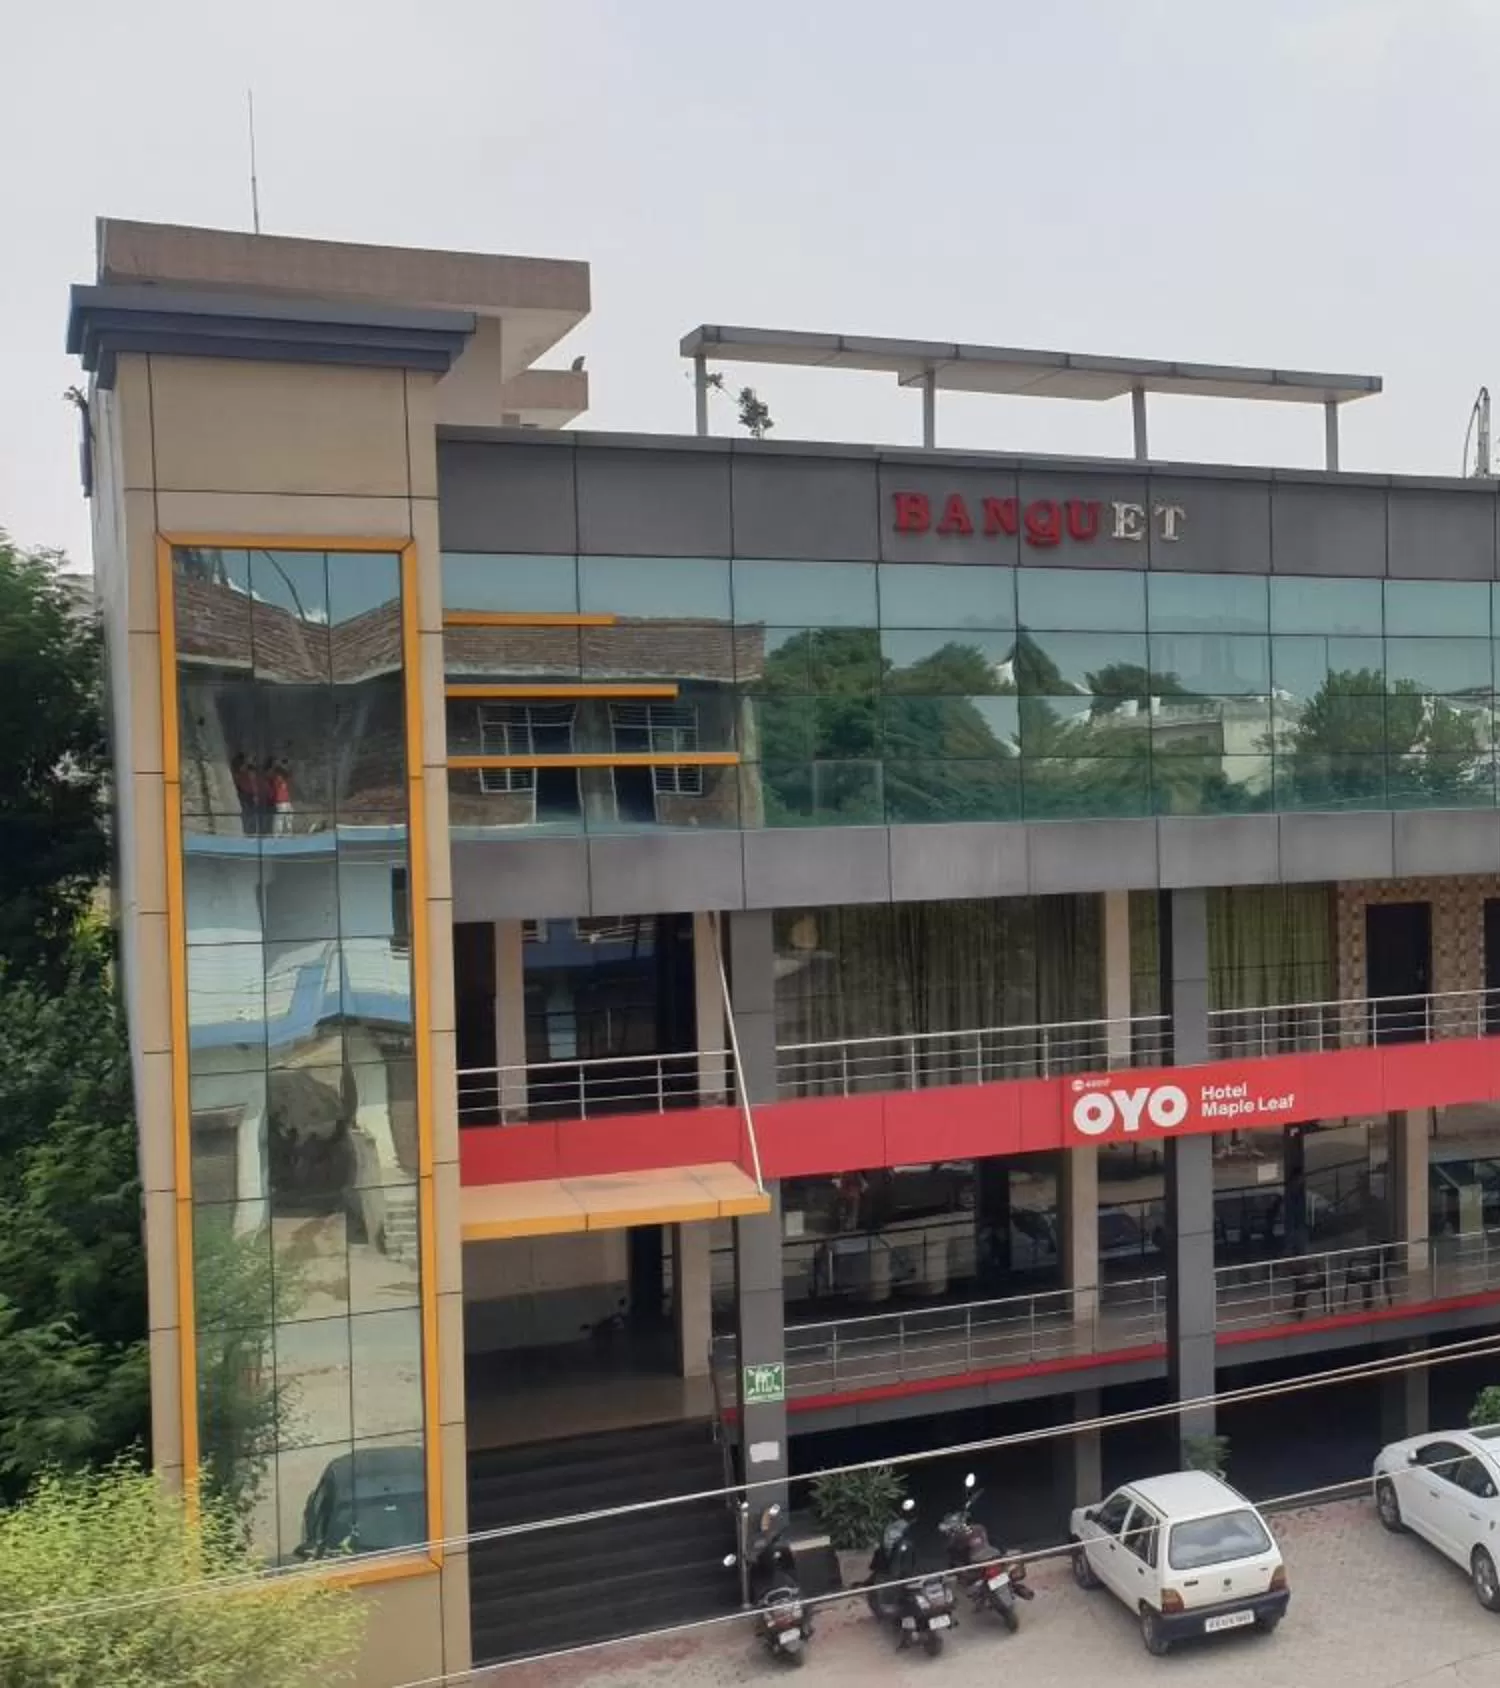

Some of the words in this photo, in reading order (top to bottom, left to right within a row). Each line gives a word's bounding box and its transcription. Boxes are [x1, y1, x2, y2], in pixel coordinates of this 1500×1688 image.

[892, 491, 1186, 548] BANQUET
[1201, 1081, 1248, 1101] Hotel
[1201, 1099, 1254, 1118] Maple
[1258, 1094, 1295, 1111] Leaf
[1073, 1085, 1188, 1135] OYO
